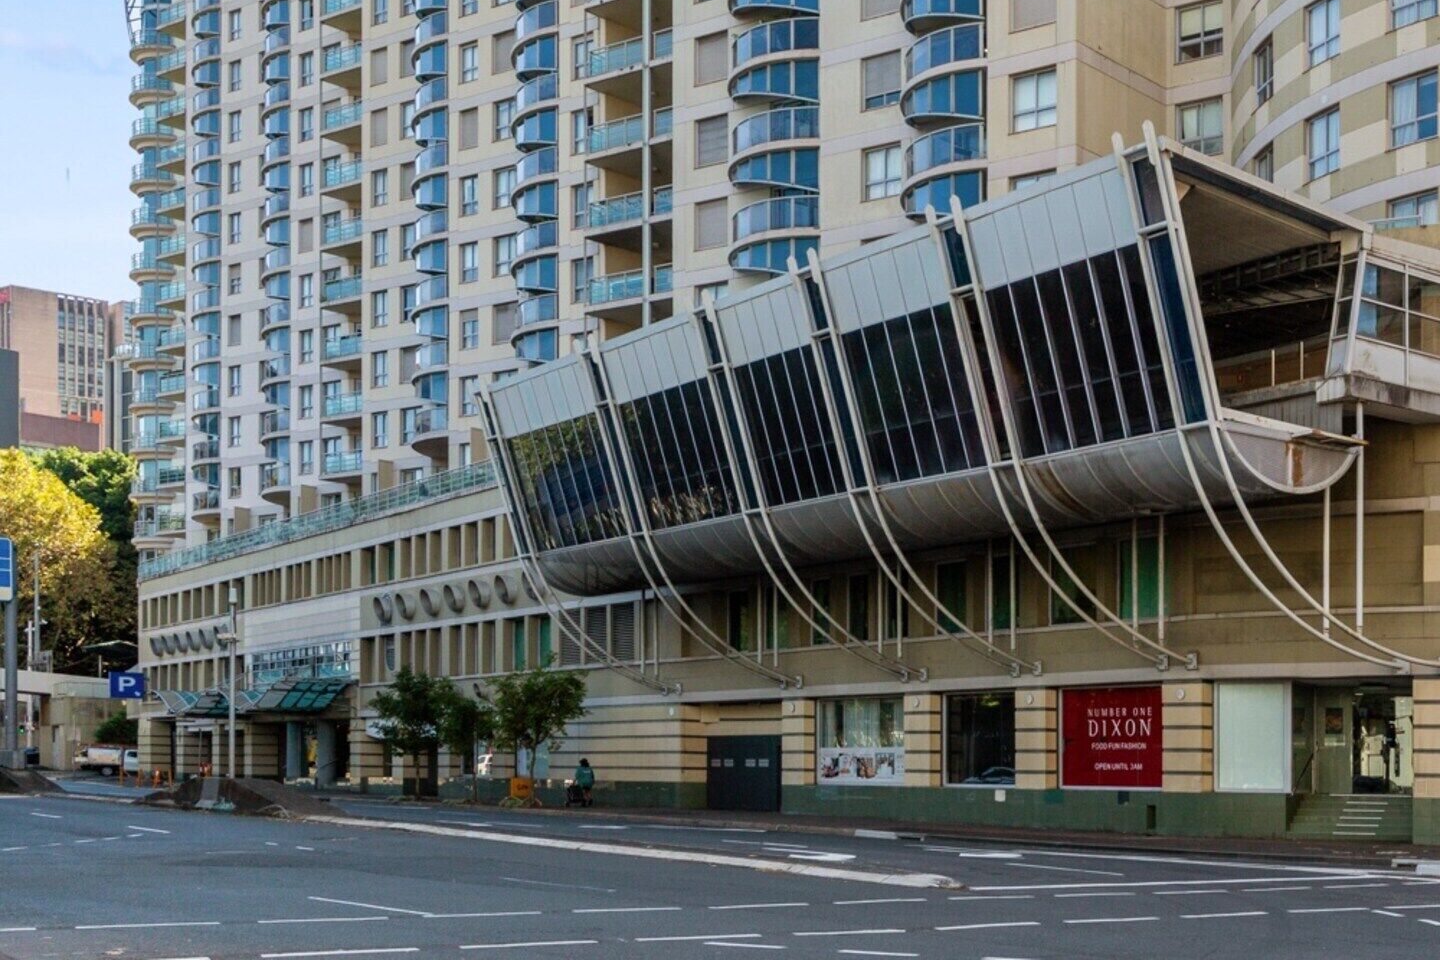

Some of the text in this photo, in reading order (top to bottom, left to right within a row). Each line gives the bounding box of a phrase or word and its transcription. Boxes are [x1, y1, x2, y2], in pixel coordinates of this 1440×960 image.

[118, 676, 136, 692] P
[1087, 707, 1152, 717] NUMBER ONE
[1087, 718, 1152, 737] DIXON
[1091, 742, 1108, 750] FOOD
